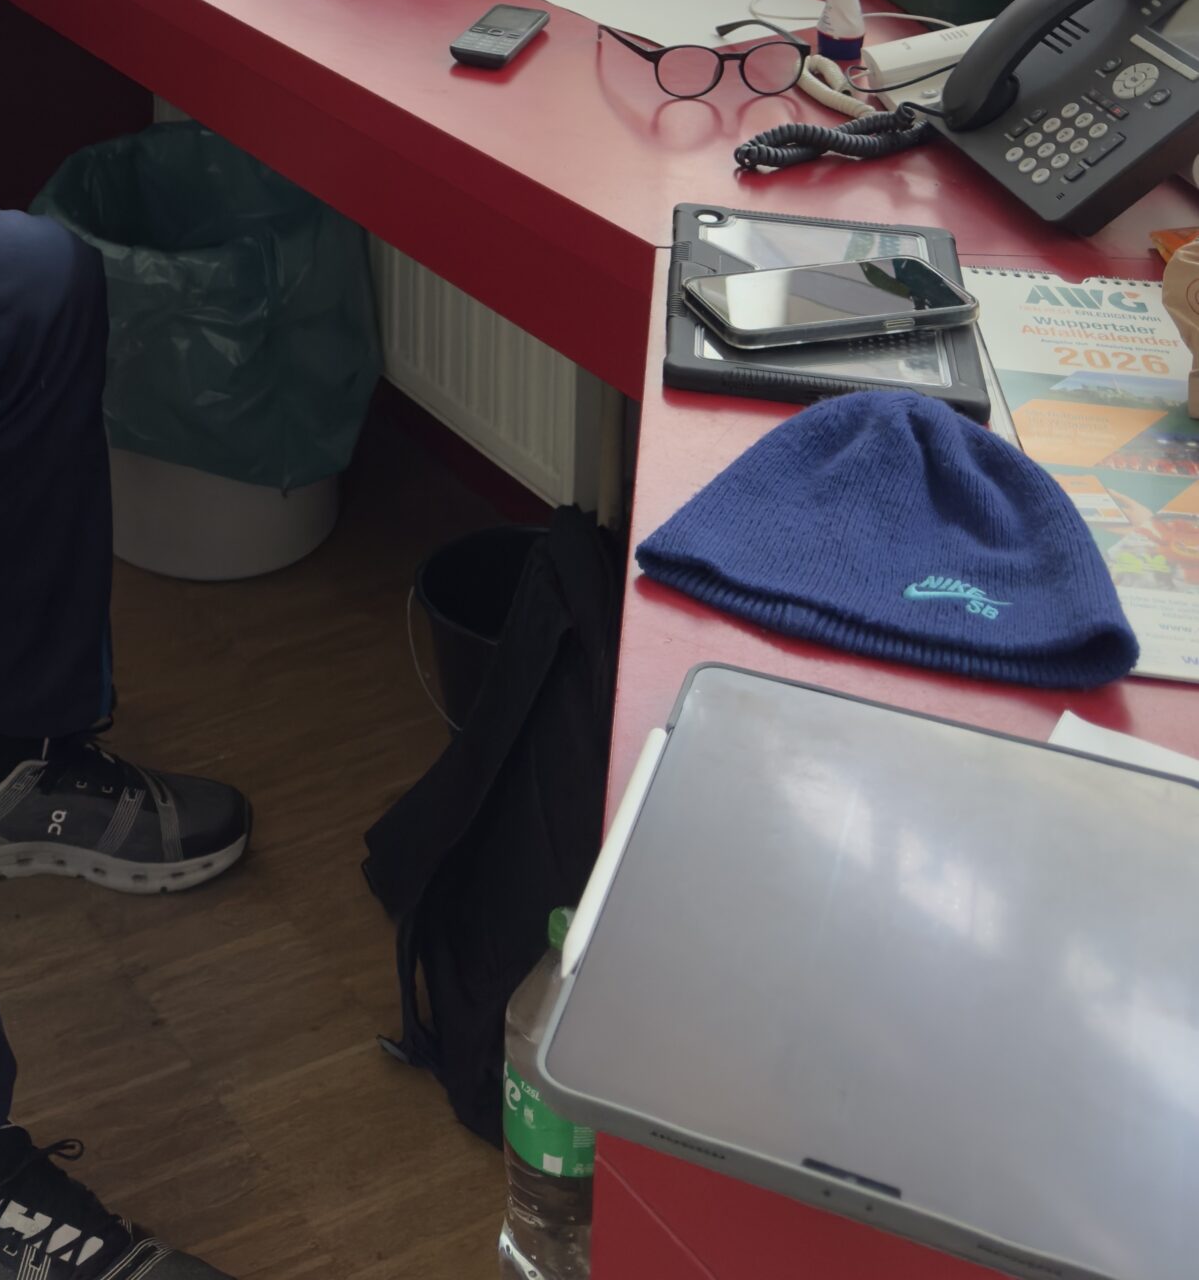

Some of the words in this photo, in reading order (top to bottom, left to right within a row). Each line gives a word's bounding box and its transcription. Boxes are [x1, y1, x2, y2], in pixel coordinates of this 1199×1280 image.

[1025, 285, 1149, 313] AWG
[1021, 324, 1180, 348] Abfallkalender
[1033, 316, 1157, 335] Wuppertaler
[1053, 346, 1170, 374] 2026
[919, 575, 987, 597] NIKE
[965, 600, 999, 619] SB
[520, 1080, 541, 1102] 1.25L
